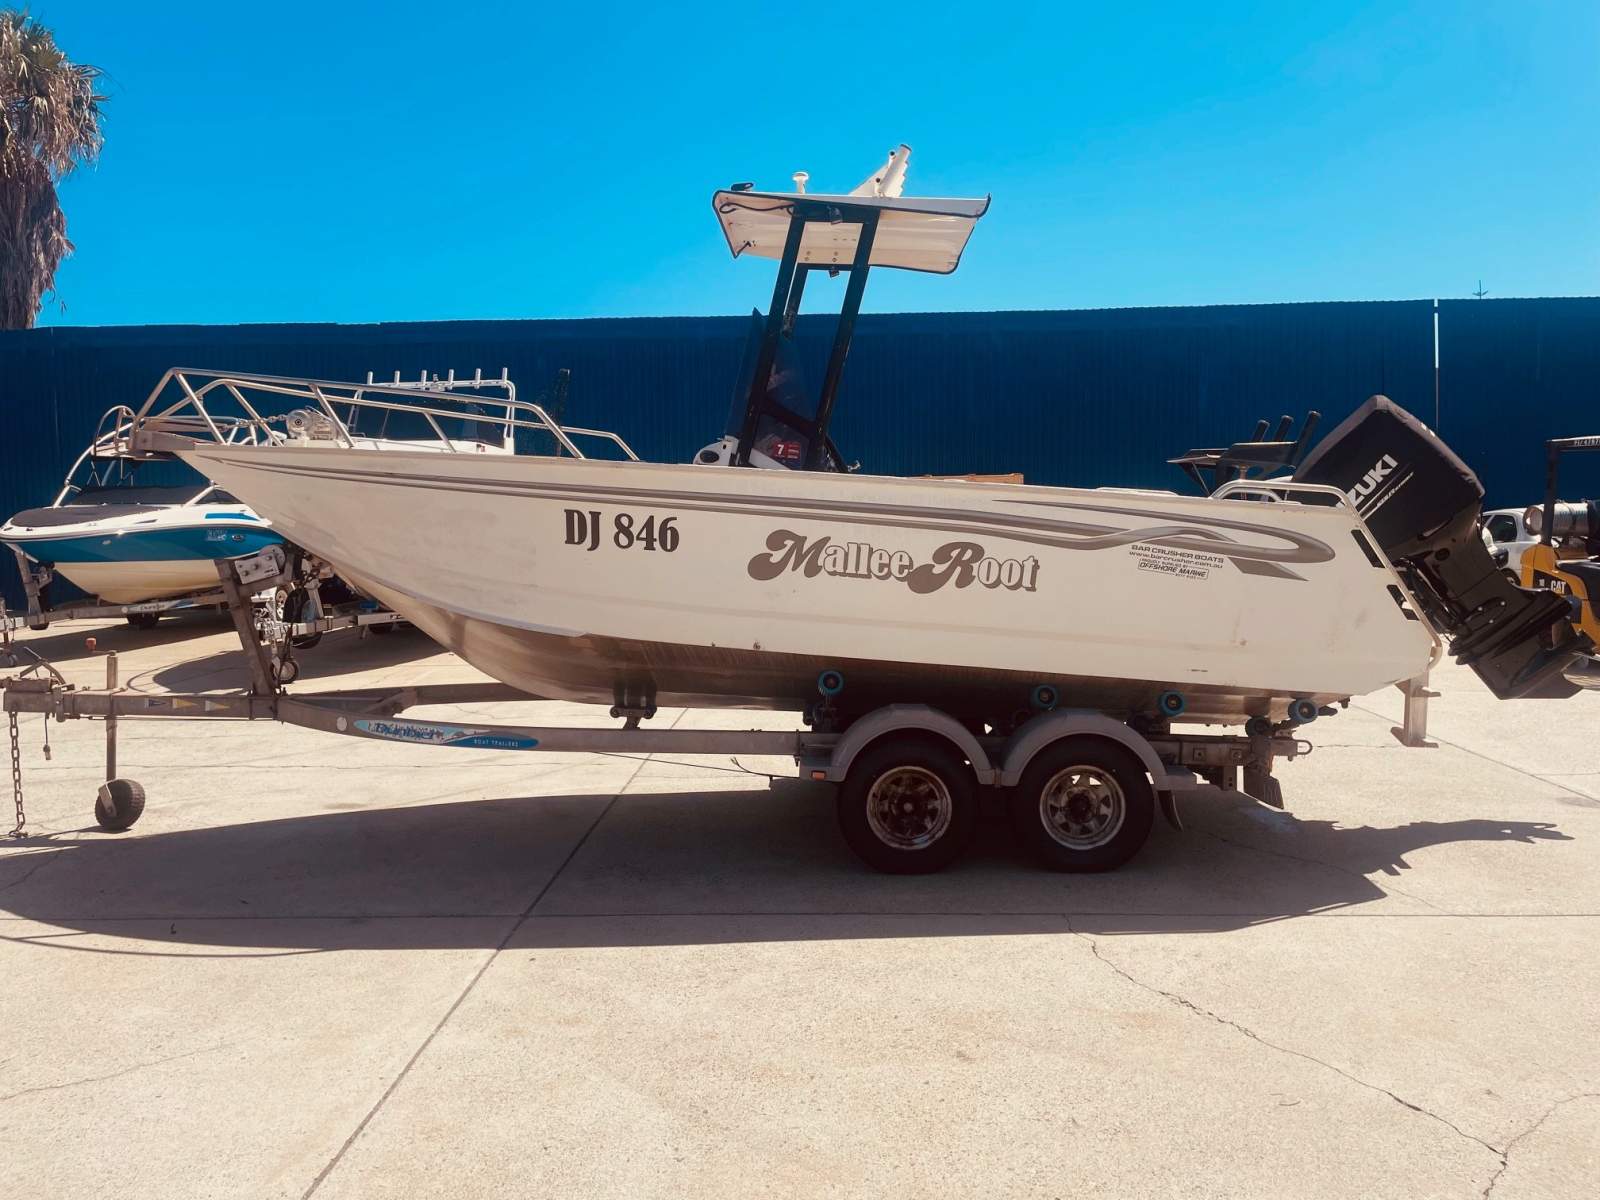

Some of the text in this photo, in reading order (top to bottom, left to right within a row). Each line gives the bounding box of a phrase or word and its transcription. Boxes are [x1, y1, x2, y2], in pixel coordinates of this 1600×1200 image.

[1336, 454, 1398, 508] ZUKI
[564, 509, 680, 552] DJ 846
[747, 529, 1040, 594] Mallee Root
[1131, 544, 1224, 563] BAR CRUSHER BOATS
[1139, 562, 1178, 573] OFFSHORE
[1178, 568, 1206, 577] MARINE
[1551, 580, 1566, 595] CAT
